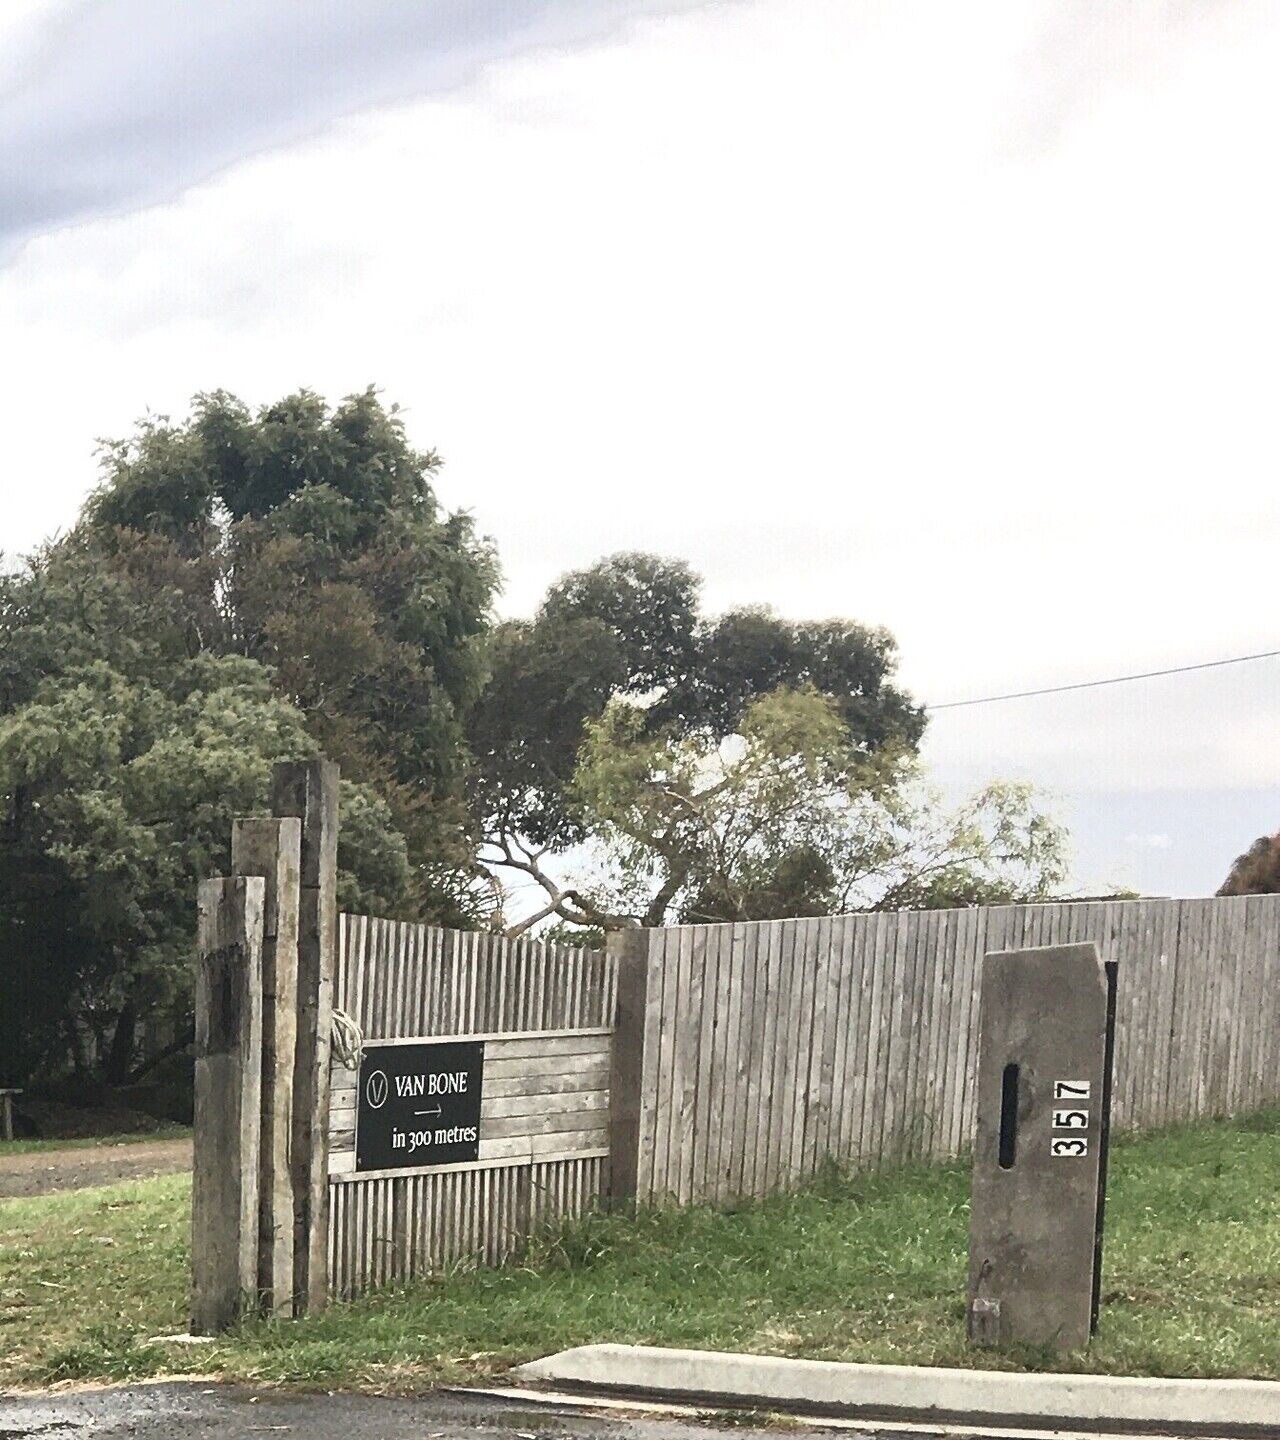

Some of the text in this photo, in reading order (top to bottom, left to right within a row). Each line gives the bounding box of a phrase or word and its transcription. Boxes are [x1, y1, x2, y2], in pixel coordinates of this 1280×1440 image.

[395, 1072, 468, 1097] VAN BONE
[1052, 1083, 1088, 1155] 357
[392, 1126, 477, 1153] in 300 metres
